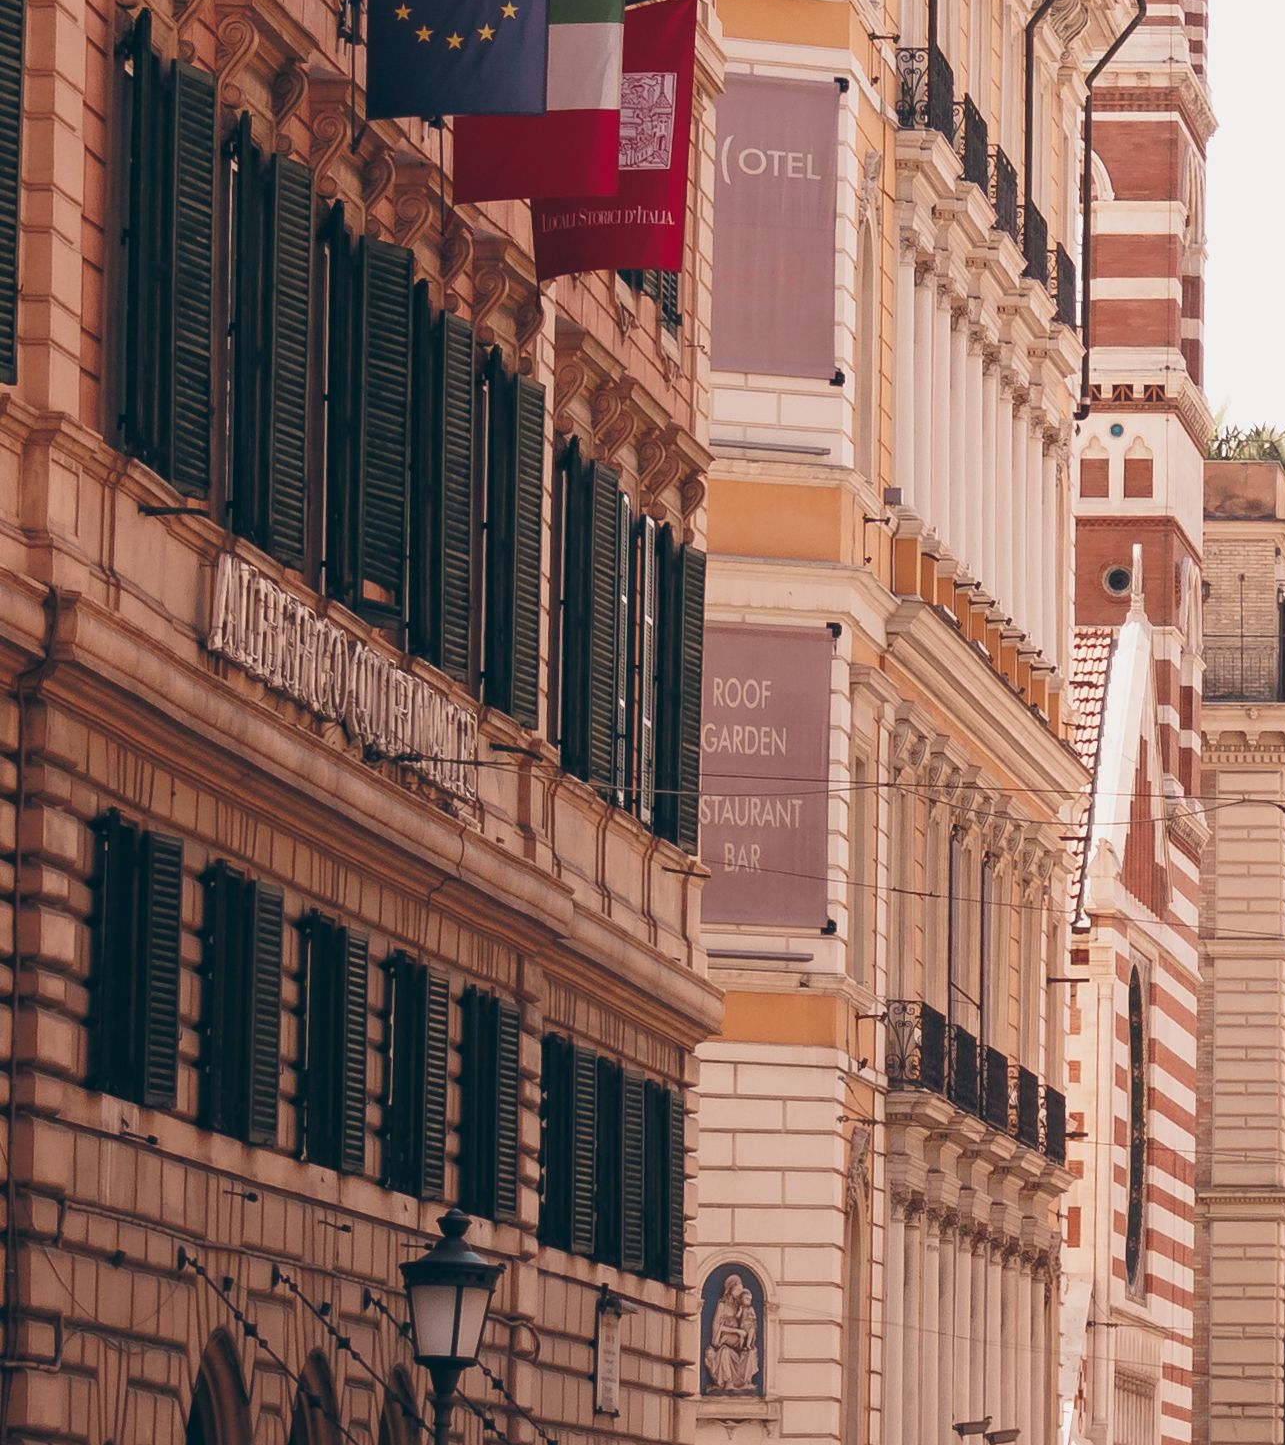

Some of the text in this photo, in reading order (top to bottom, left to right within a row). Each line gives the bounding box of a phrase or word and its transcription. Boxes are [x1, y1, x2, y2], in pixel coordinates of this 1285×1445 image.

[713, 677, 772, 709] ROOF
[702, 723, 787, 757] GARDEN
[723, 843, 761, 874] BAR
